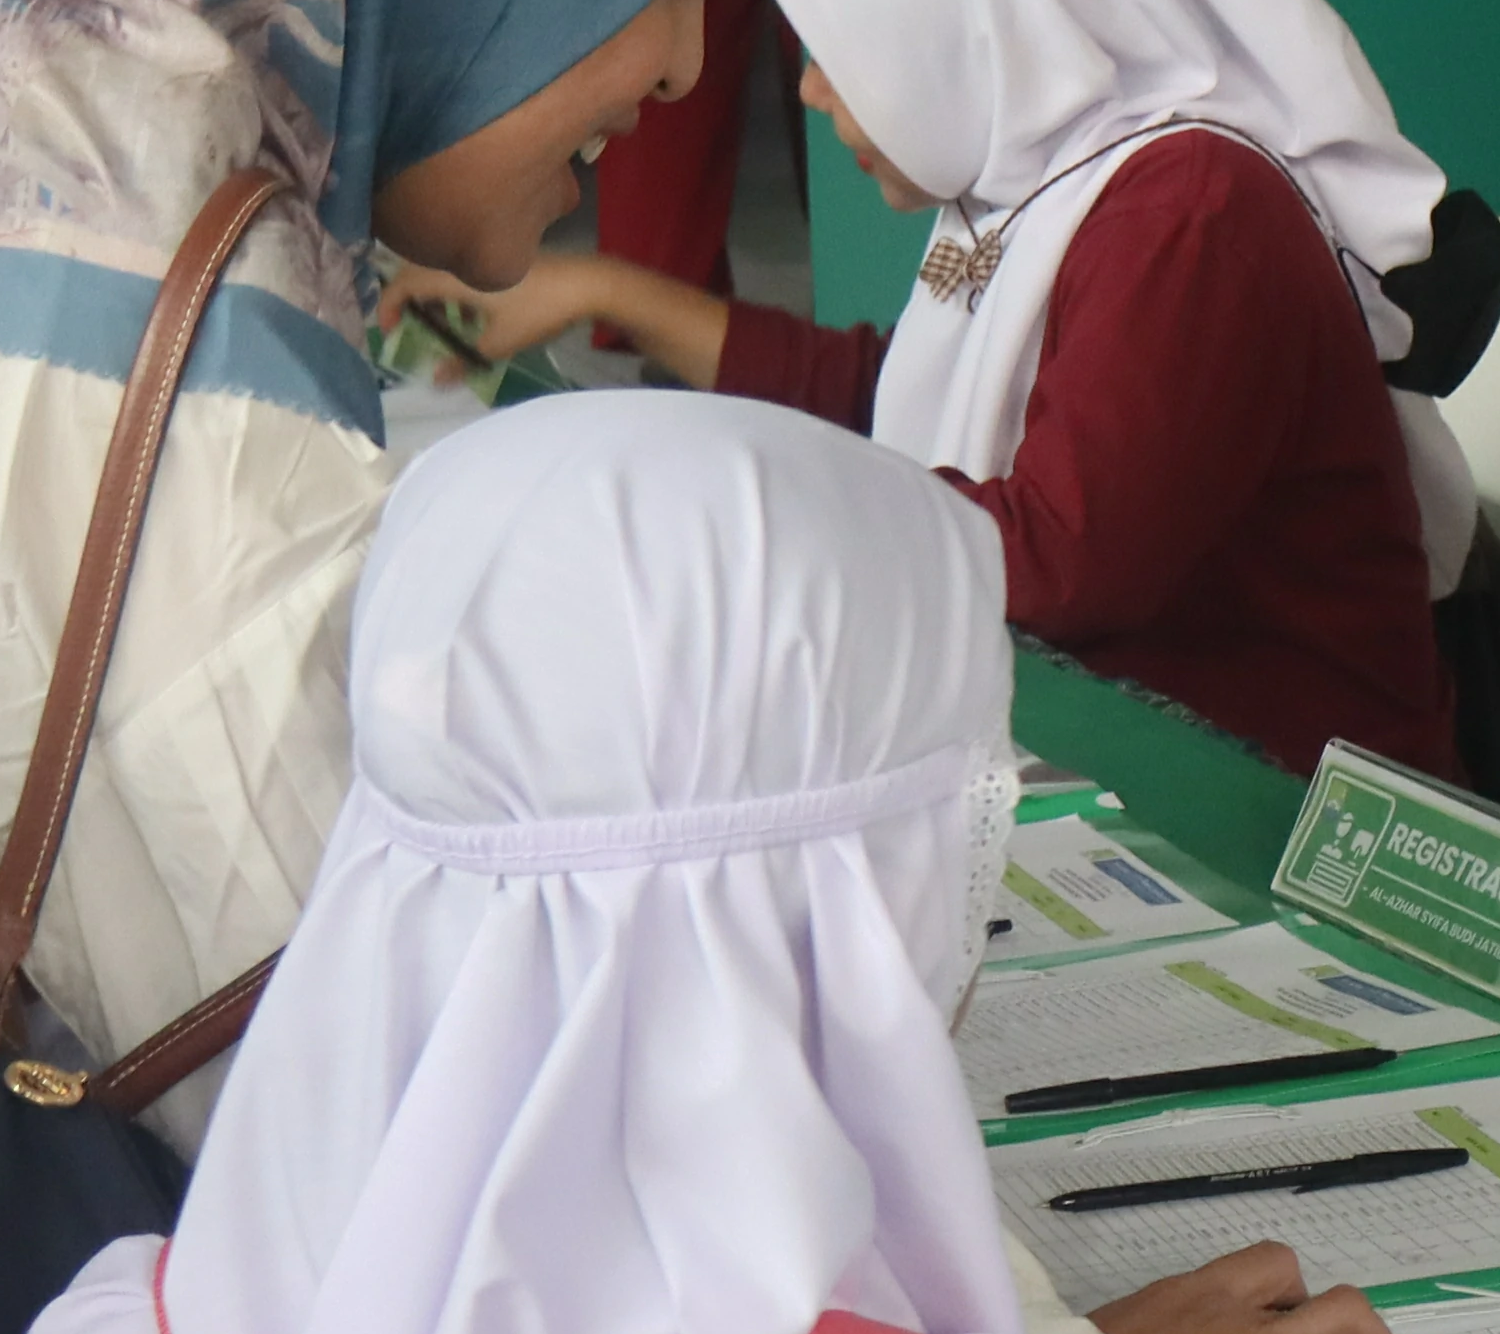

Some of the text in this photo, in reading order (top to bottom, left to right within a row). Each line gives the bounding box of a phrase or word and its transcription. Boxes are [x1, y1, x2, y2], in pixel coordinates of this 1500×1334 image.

[1369, 886, 1422, 923] AL-AZHAR
[1419, 910, 1450, 934] SYIFA
[1448, 923, 1476, 947] BUDI
